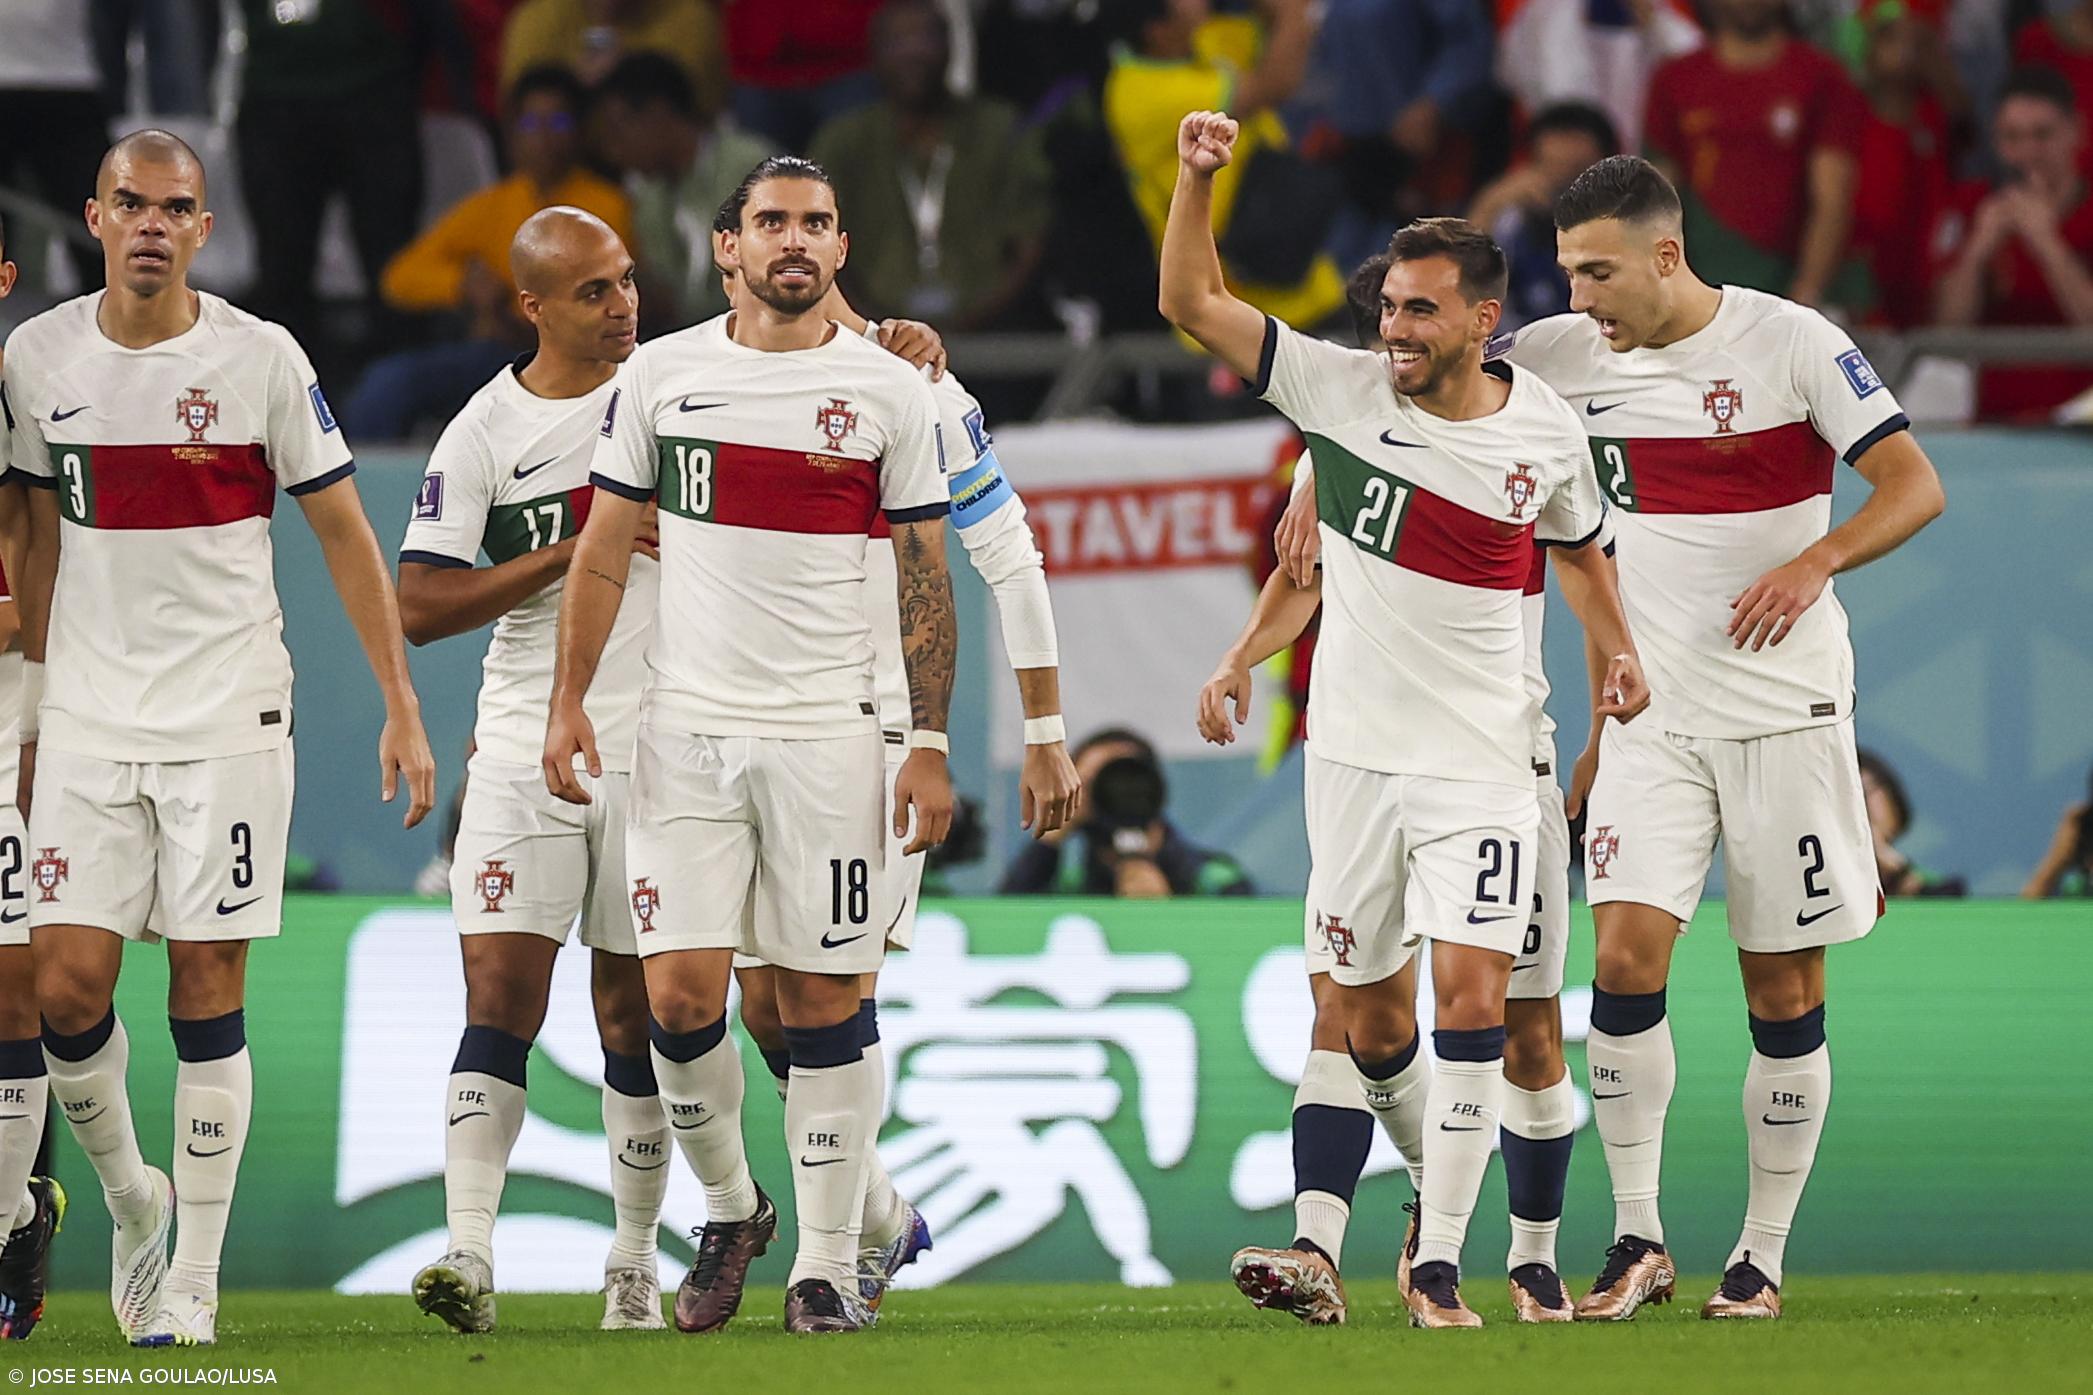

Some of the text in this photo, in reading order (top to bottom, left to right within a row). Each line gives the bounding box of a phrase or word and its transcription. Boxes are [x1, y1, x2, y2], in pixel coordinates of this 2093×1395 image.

[62, 453, 86, 519] 3
[675, 445, 712, 515] 18
[955, 475, 1003, 512] CHILDREN
[1603, 444, 1632, 506] 2
[522, 502, 564, 551] 17
[1028, 489, 1254, 564] TAVEL
[1351, 476, 1409, 553] 21
[231, 821, 253, 889] 3
[1475, 838, 1520, 906] 21
[1798, 834, 1830, 899] 2
[829, 858, 869, 925] 18
